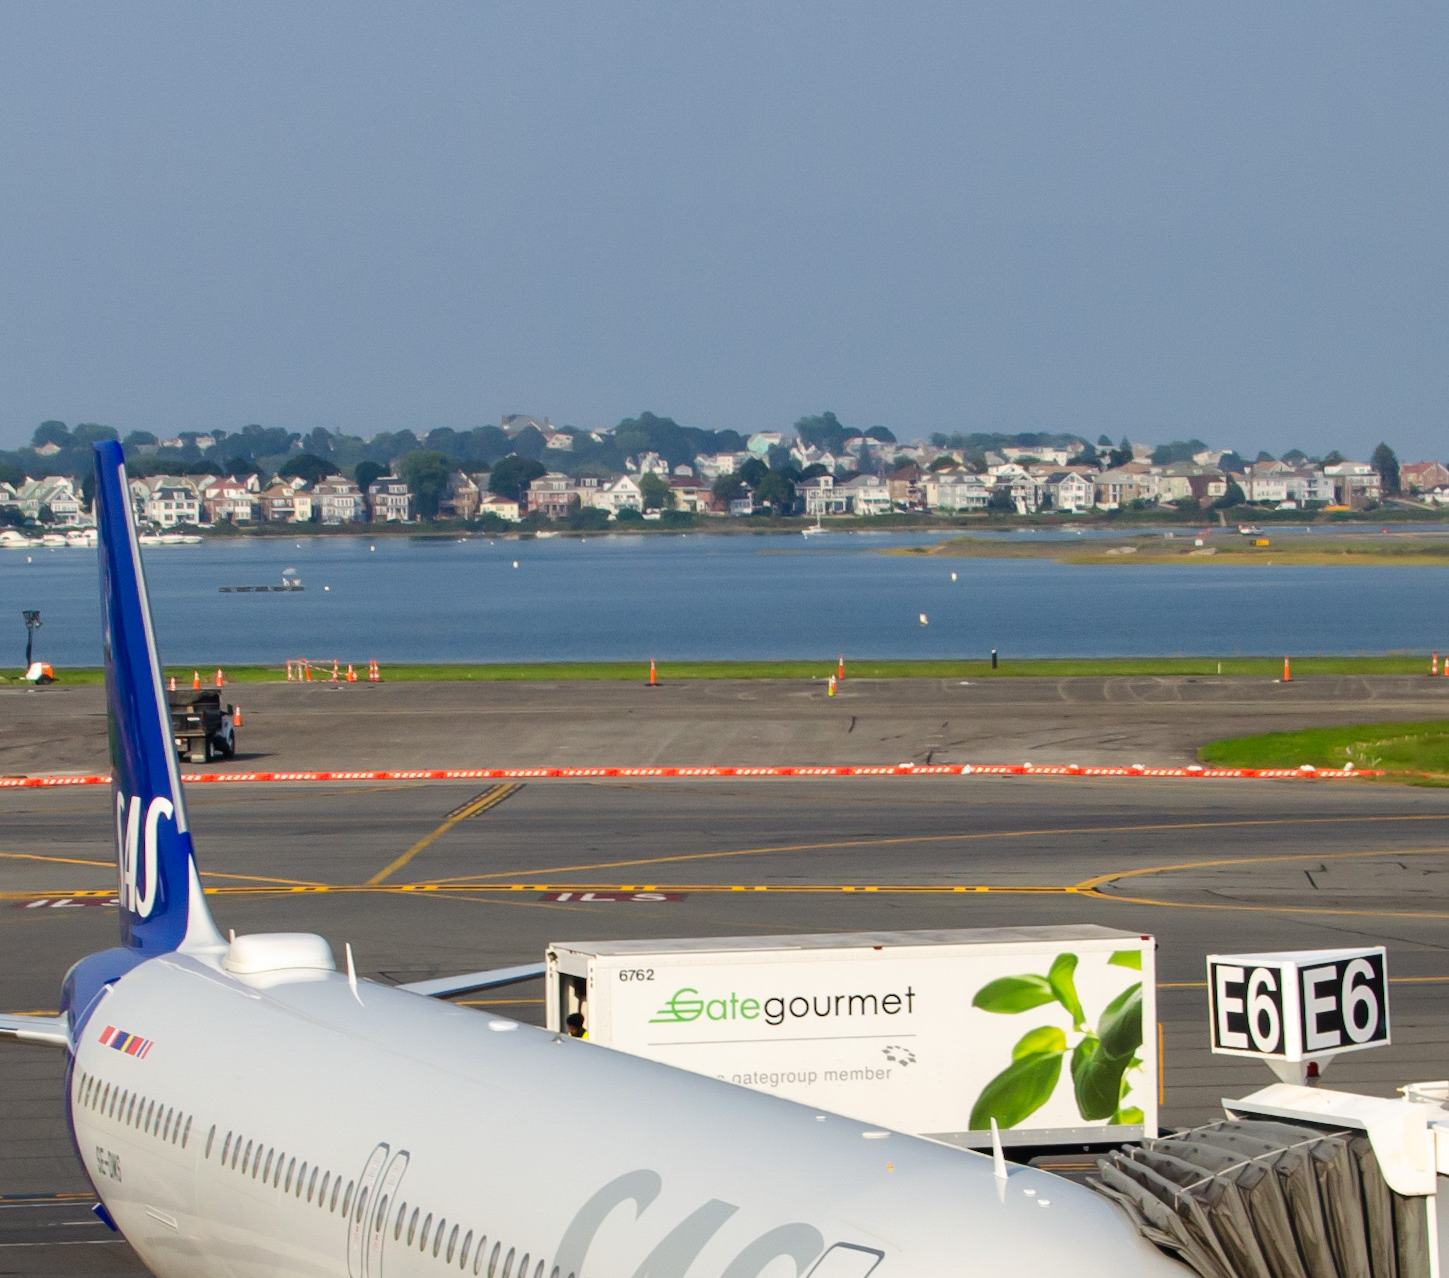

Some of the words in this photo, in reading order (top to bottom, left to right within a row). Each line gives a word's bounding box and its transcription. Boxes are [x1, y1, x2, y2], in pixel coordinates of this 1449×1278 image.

[116, 790, 173, 918] SAS
[556, 892, 667, 902] ILS
[619, 968, 655, 982] 6762
[1216, 964, 1281, 1053] E6
[1303, 958, 1379, 1051] E6
[824, 1066, 892, 1082] member
